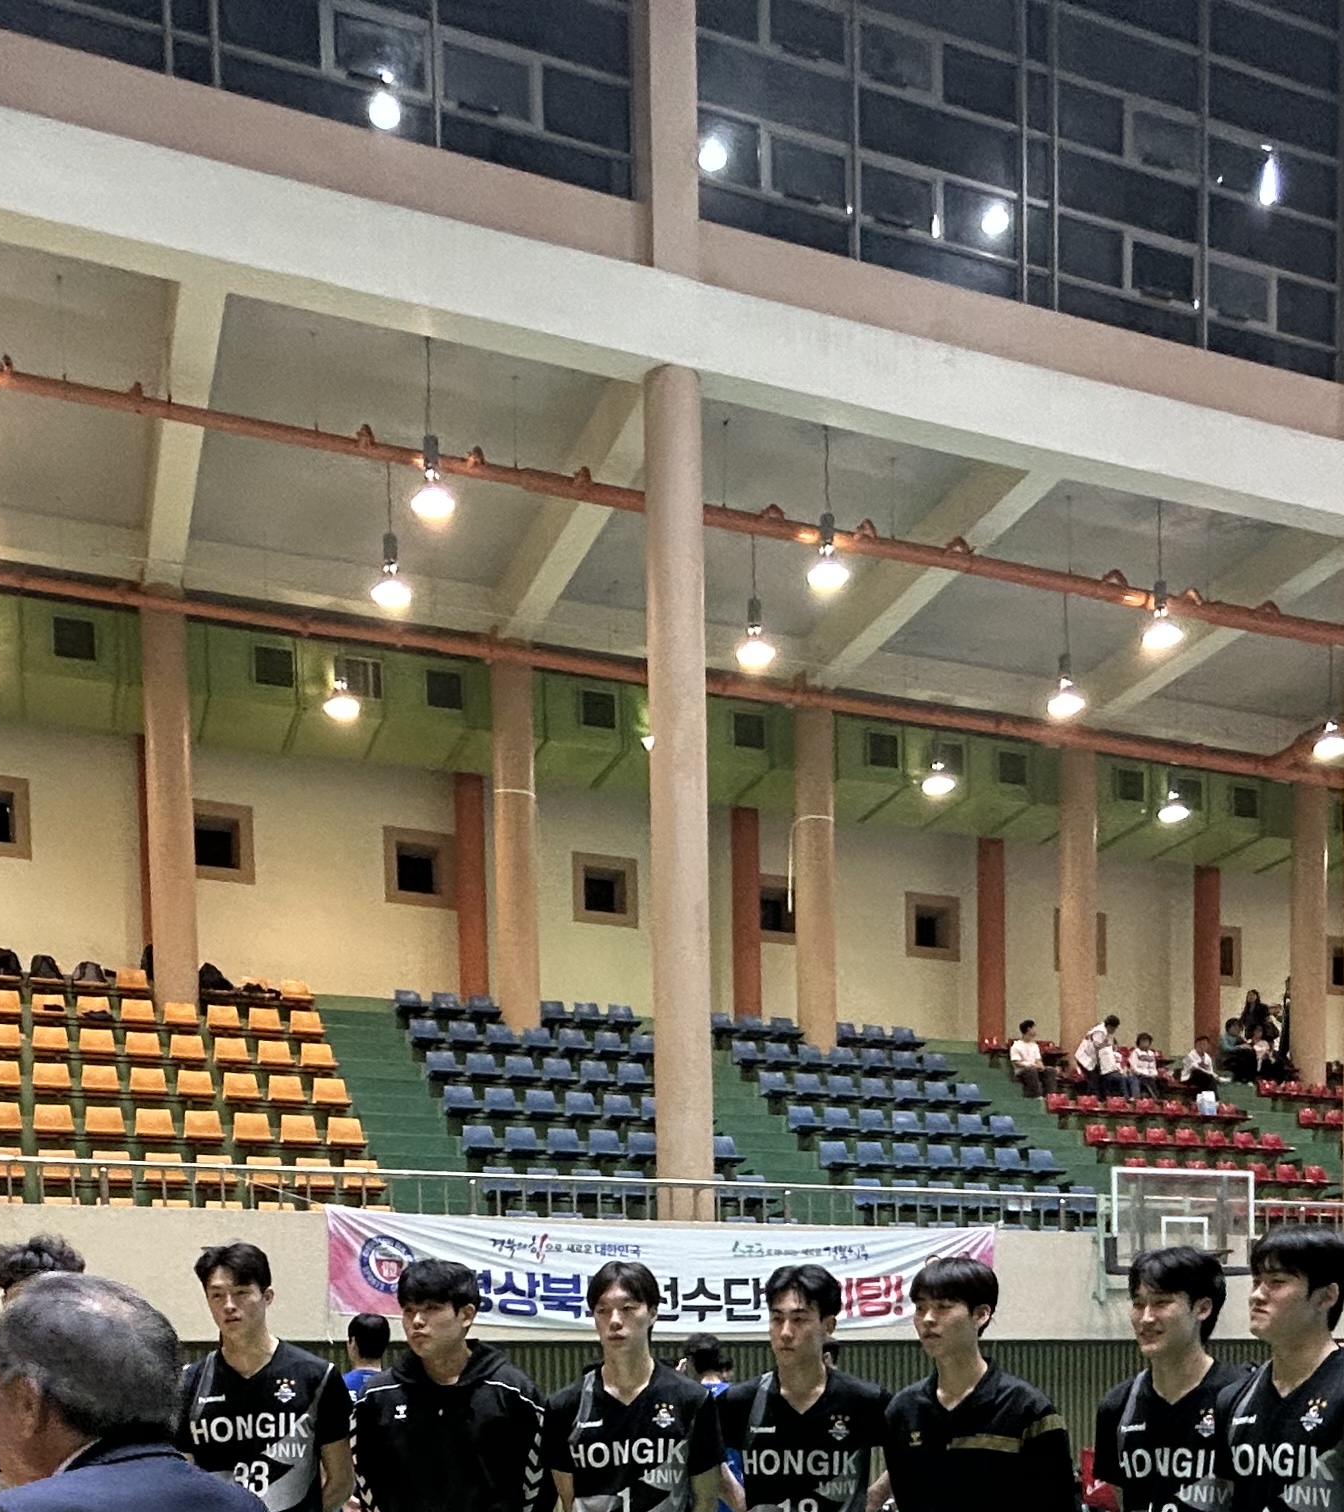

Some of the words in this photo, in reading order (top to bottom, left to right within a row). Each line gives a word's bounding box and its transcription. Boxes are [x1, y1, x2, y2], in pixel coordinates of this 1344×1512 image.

[594, 1243, 641, 1257] 대한민국
[190, 1412, 309, 1445] HONGIK
[266, 1443, 306, 1458] UNIV
[569, 1438, 688, 1469] HONGIK
[742, 1450, 860, 1476] HONGIK
[643, 1469, 684, 1484] UNIV
[1283, 1484, 1332, 1508] UNIV
